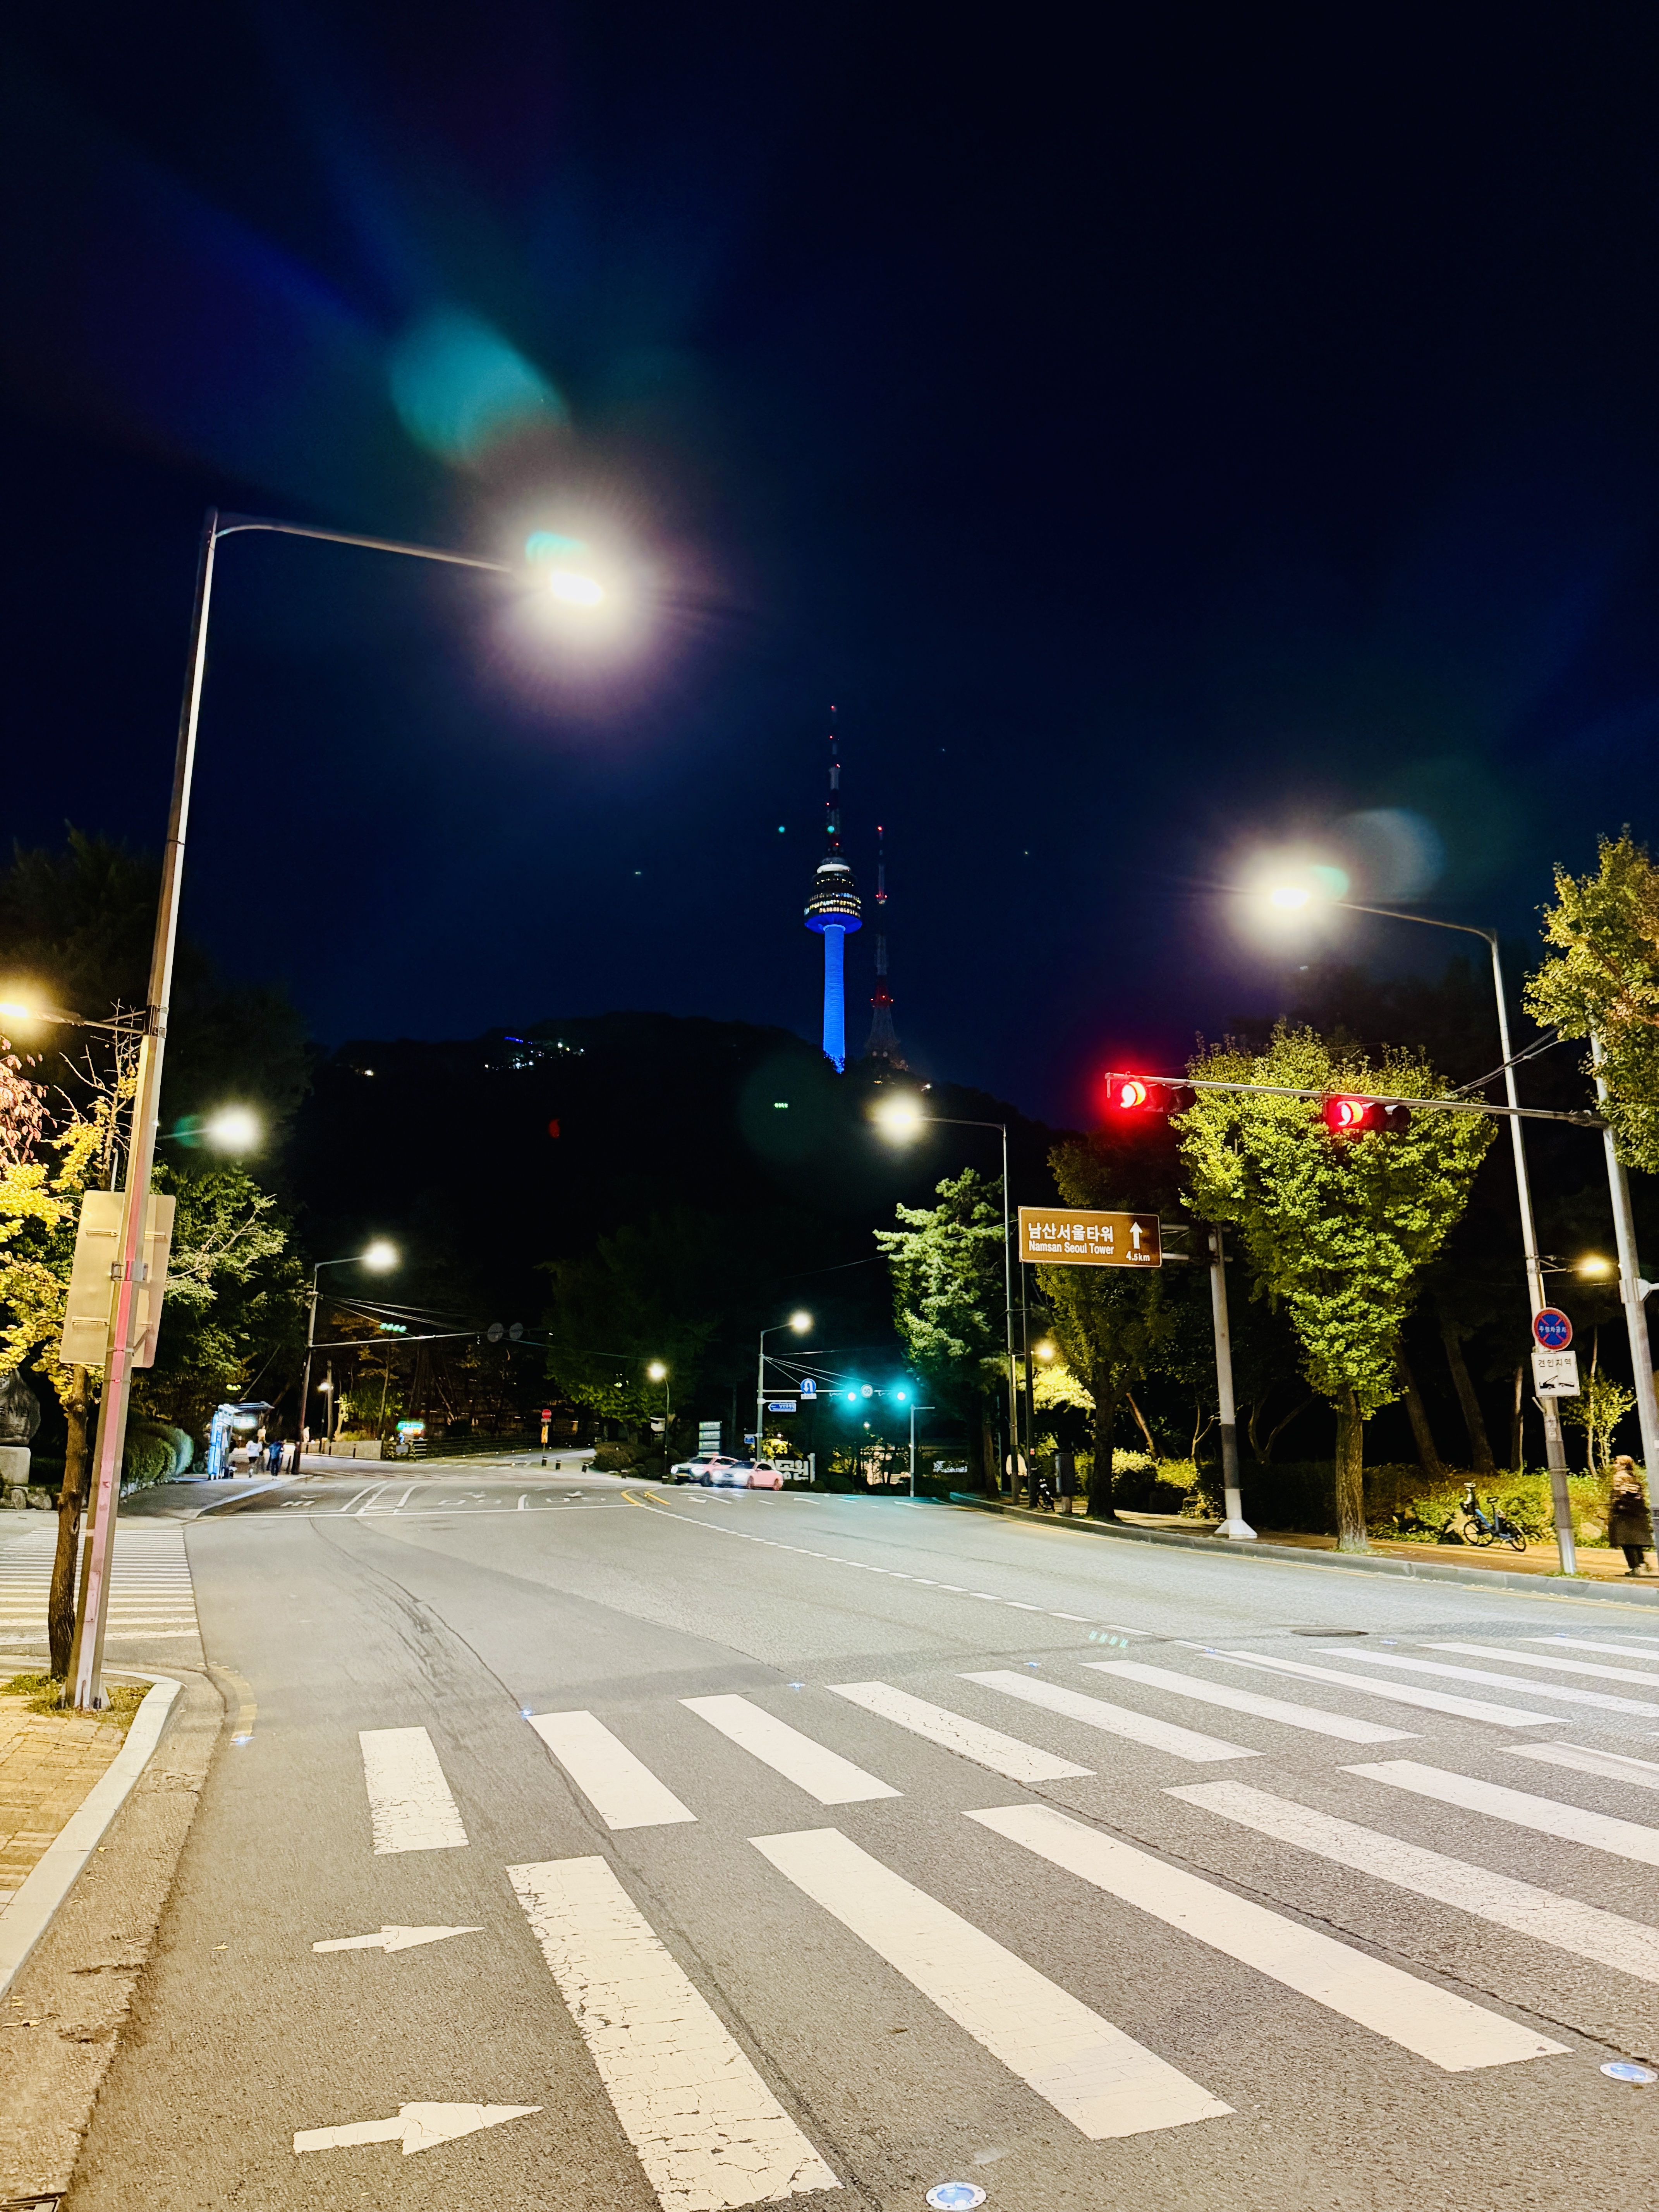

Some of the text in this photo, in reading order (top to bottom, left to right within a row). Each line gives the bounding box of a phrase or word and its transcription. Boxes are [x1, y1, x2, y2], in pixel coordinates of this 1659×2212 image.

[1028, 1222, 1113, 1243] 남산서울타워
[1029, 1240, 1114, 1255] Namsan Seoul Tower
[1126, 1250, 1150, 1262] 4.5km
[1538, 1358, 1571, 1367] 견인지역
